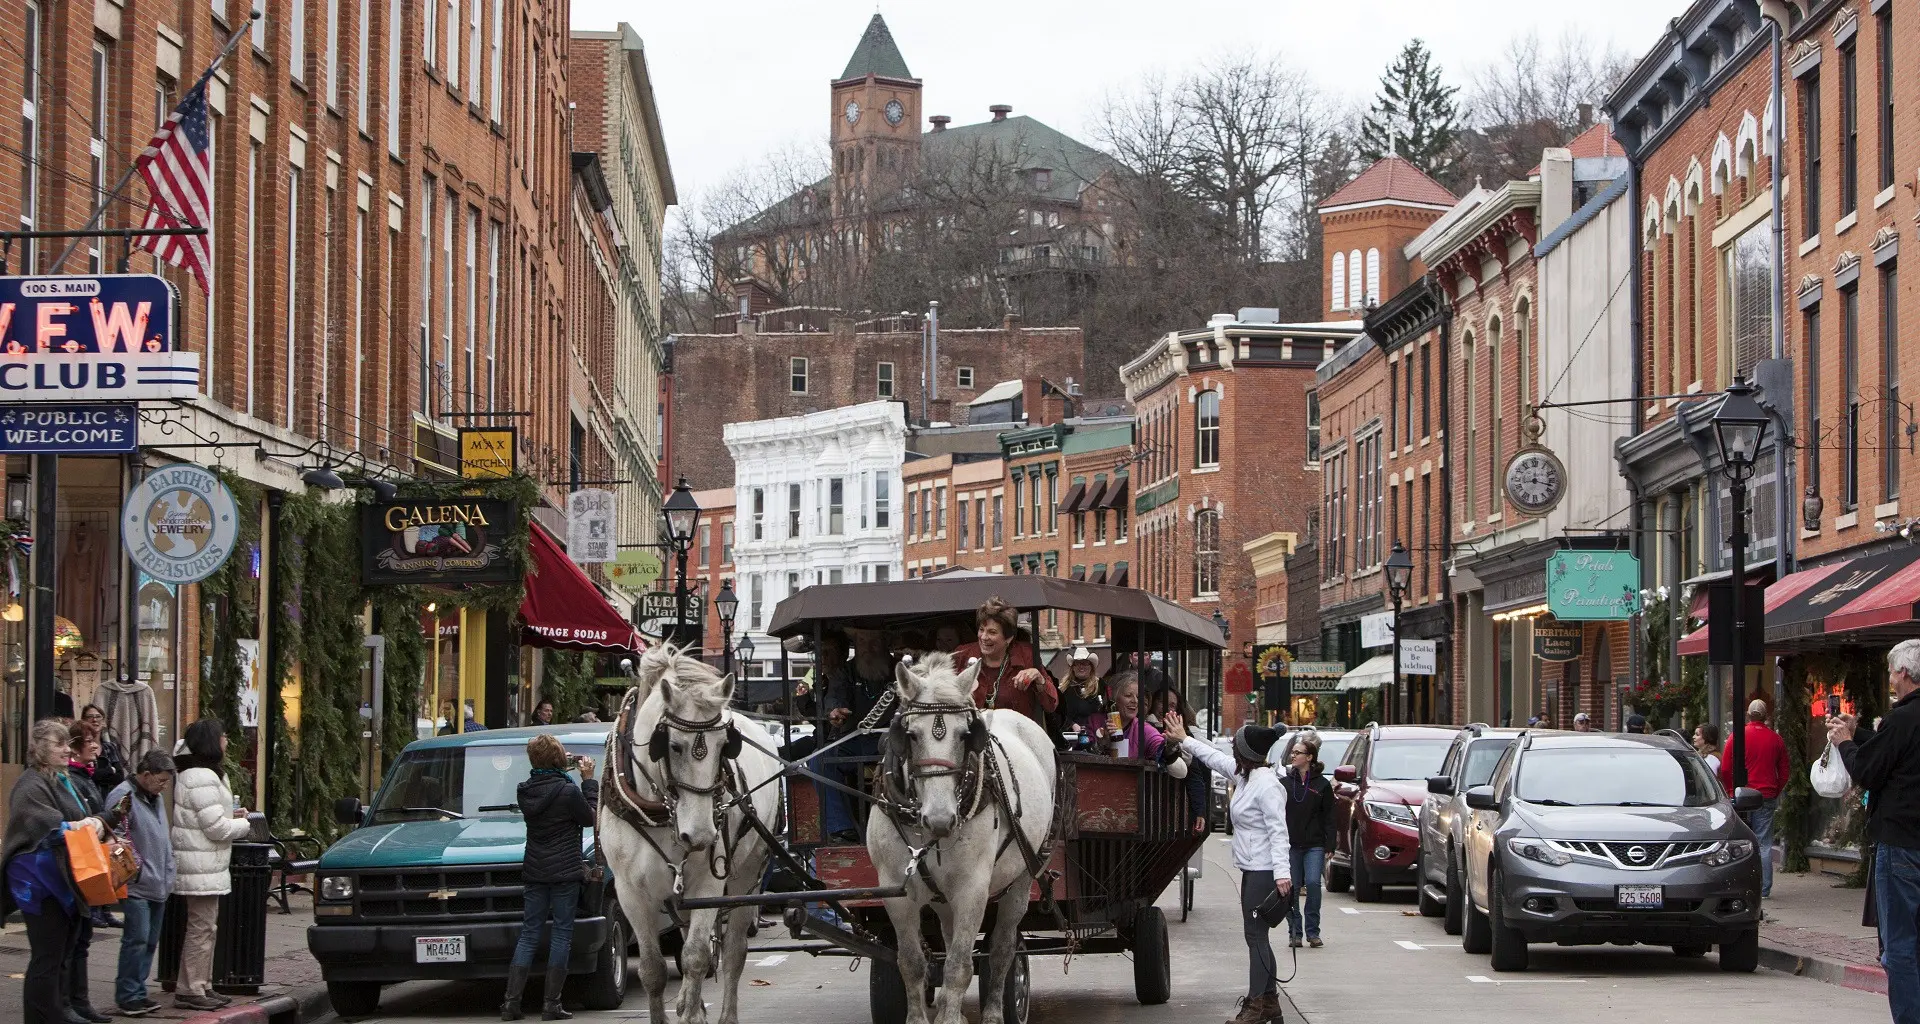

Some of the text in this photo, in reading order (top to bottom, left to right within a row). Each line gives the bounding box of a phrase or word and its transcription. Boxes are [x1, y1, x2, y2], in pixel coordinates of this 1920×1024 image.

[26, 284, 96, 293] 100 S. MAIN
[0, 362, 126, 390] CLUB
[22, 411, 108, 425] PUBLIC
[6, 429, 124, 443] WELCOME
[471, 440, 505, 450] MAX
[148, 470, 216, 494] EARTH'S
[384, 503, 490, 532] GALENA
[152, 525, 206, 534] JEWELRY
[135, 541, 223, 578] TREASURES
[394, 557, 485, 571] CANNING COMPANY
[1574, 553, 1614, 571] Petals
[628, 566, 659, 574] BLACK
[642, 595, 700, 616] KLEI'S
[528, 625, 608, 640] NTAGE SODAS
[1534, 628, 1581, 637] HERITAGE
[1545, 638, 1571, 647] Lace
[1620, 892, 1661, 904] E25 5608
[427, 943, 461, 956] MR4434
